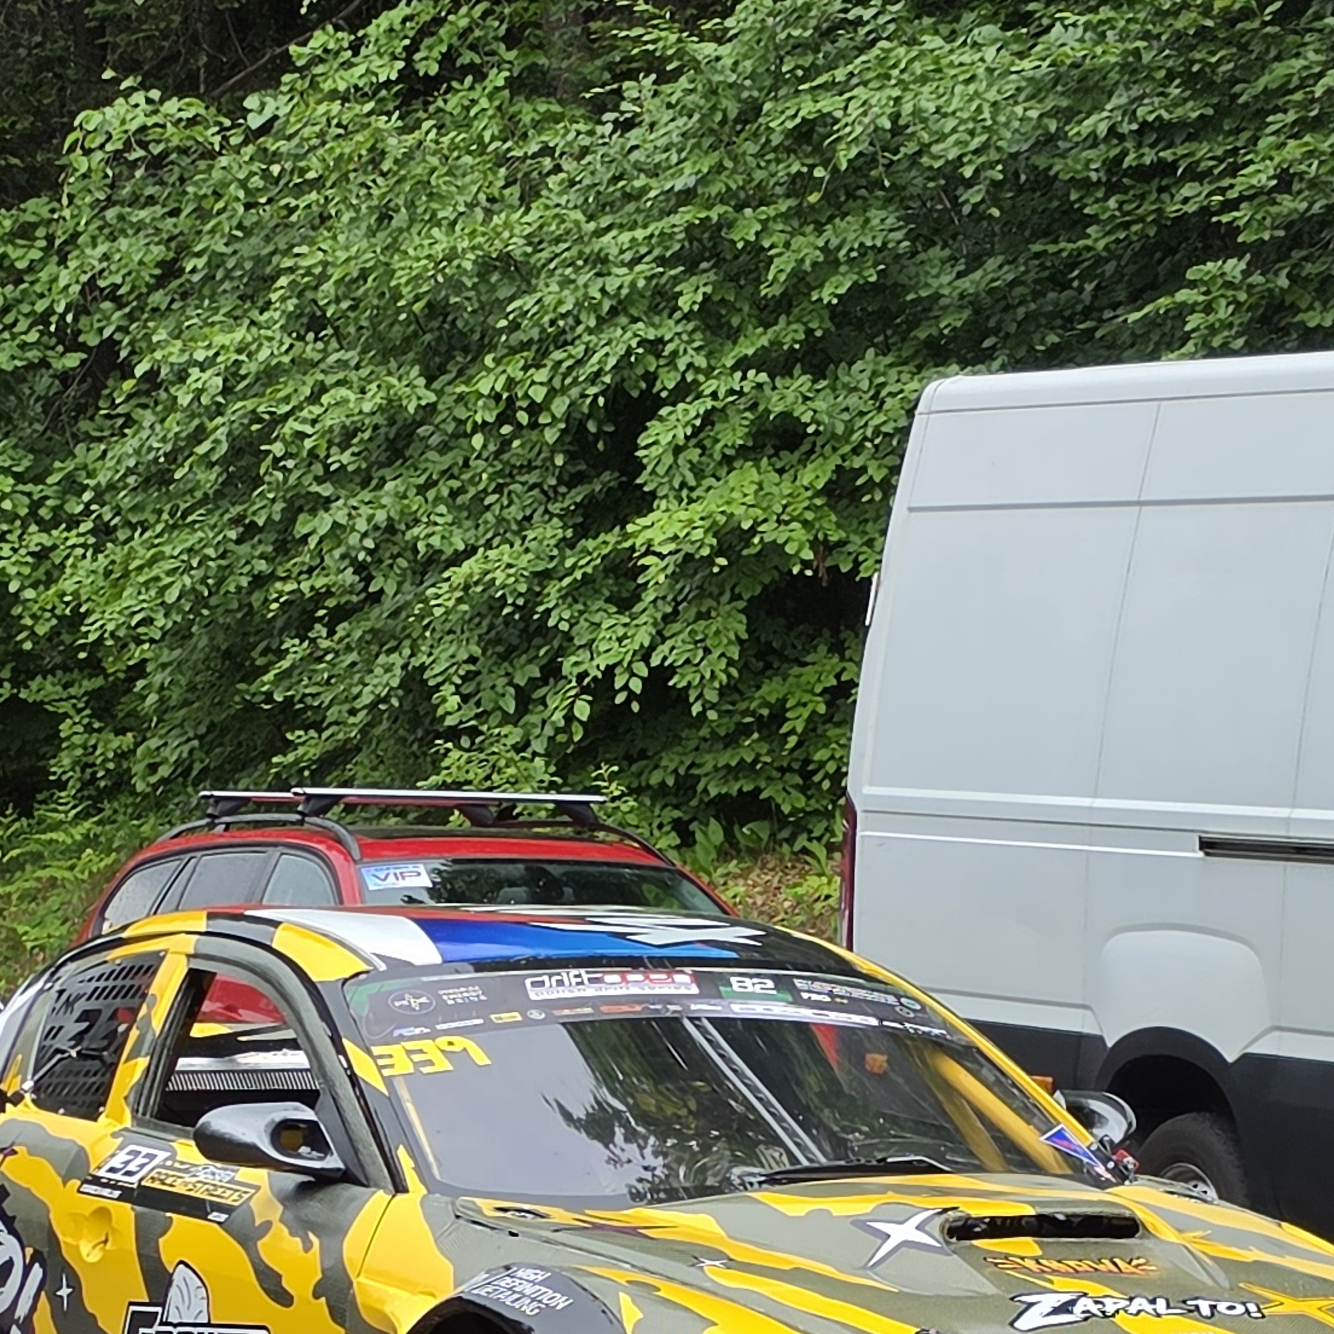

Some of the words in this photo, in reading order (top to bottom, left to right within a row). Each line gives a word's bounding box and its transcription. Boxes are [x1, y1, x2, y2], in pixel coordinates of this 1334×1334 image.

[371, 870, 422, 882] VIP
[370, 1035, 492, 1077] 339
[104, 1148, 160, 1178] 33
[471, 1285, 546, 1316] DETAILING
[491, 1276, 574, 1310] DEFINITION
[1010, 1291, 1186, 1332] ZAPAL
[1185, 1298, 1266, 1319] TO!
